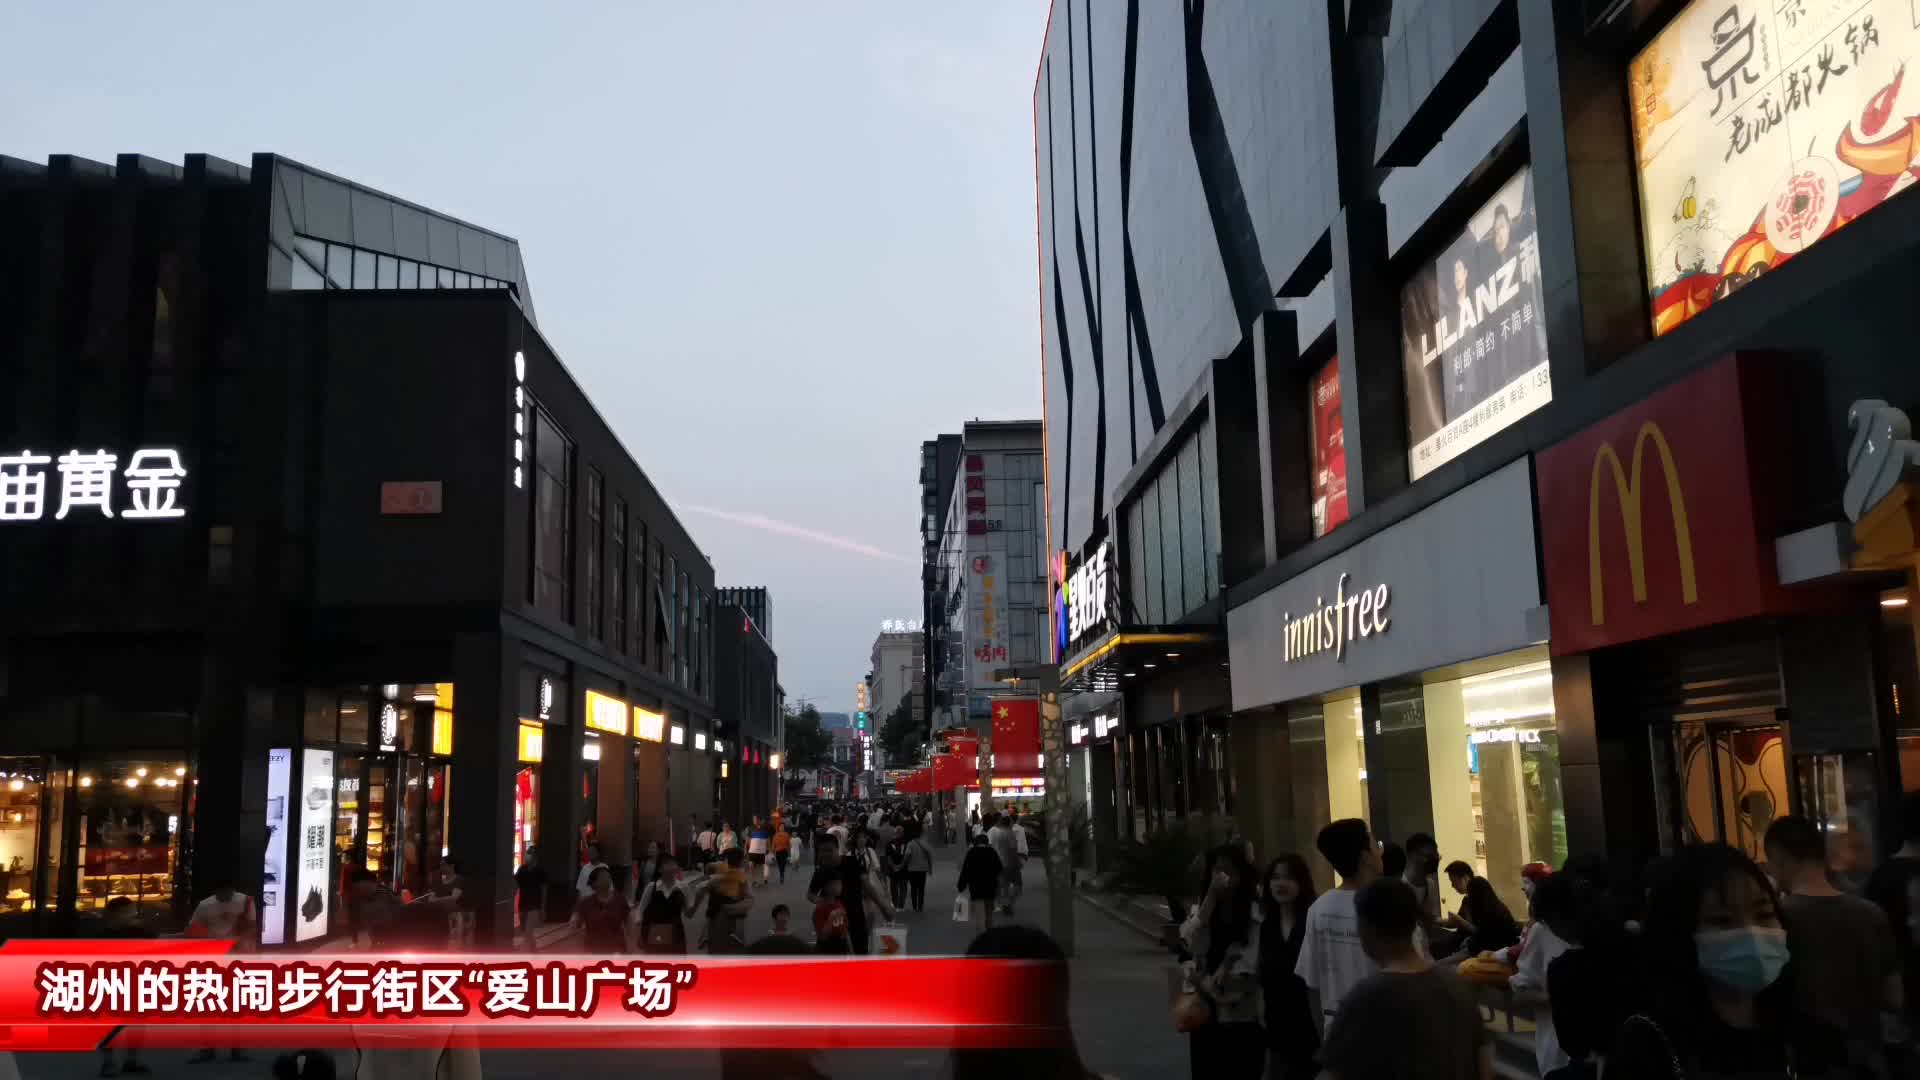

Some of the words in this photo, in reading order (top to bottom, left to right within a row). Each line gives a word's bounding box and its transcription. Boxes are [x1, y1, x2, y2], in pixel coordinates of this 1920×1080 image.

[1725, 14, 1880, 165] 老成都火锅
[1421, 255, 1520, 368] LILANZ
[1500, 301, 1535, 341] 不简单
[0, 448, 188, 521] 庙黄金
[1283, 572, 1389, 662] innisfree
